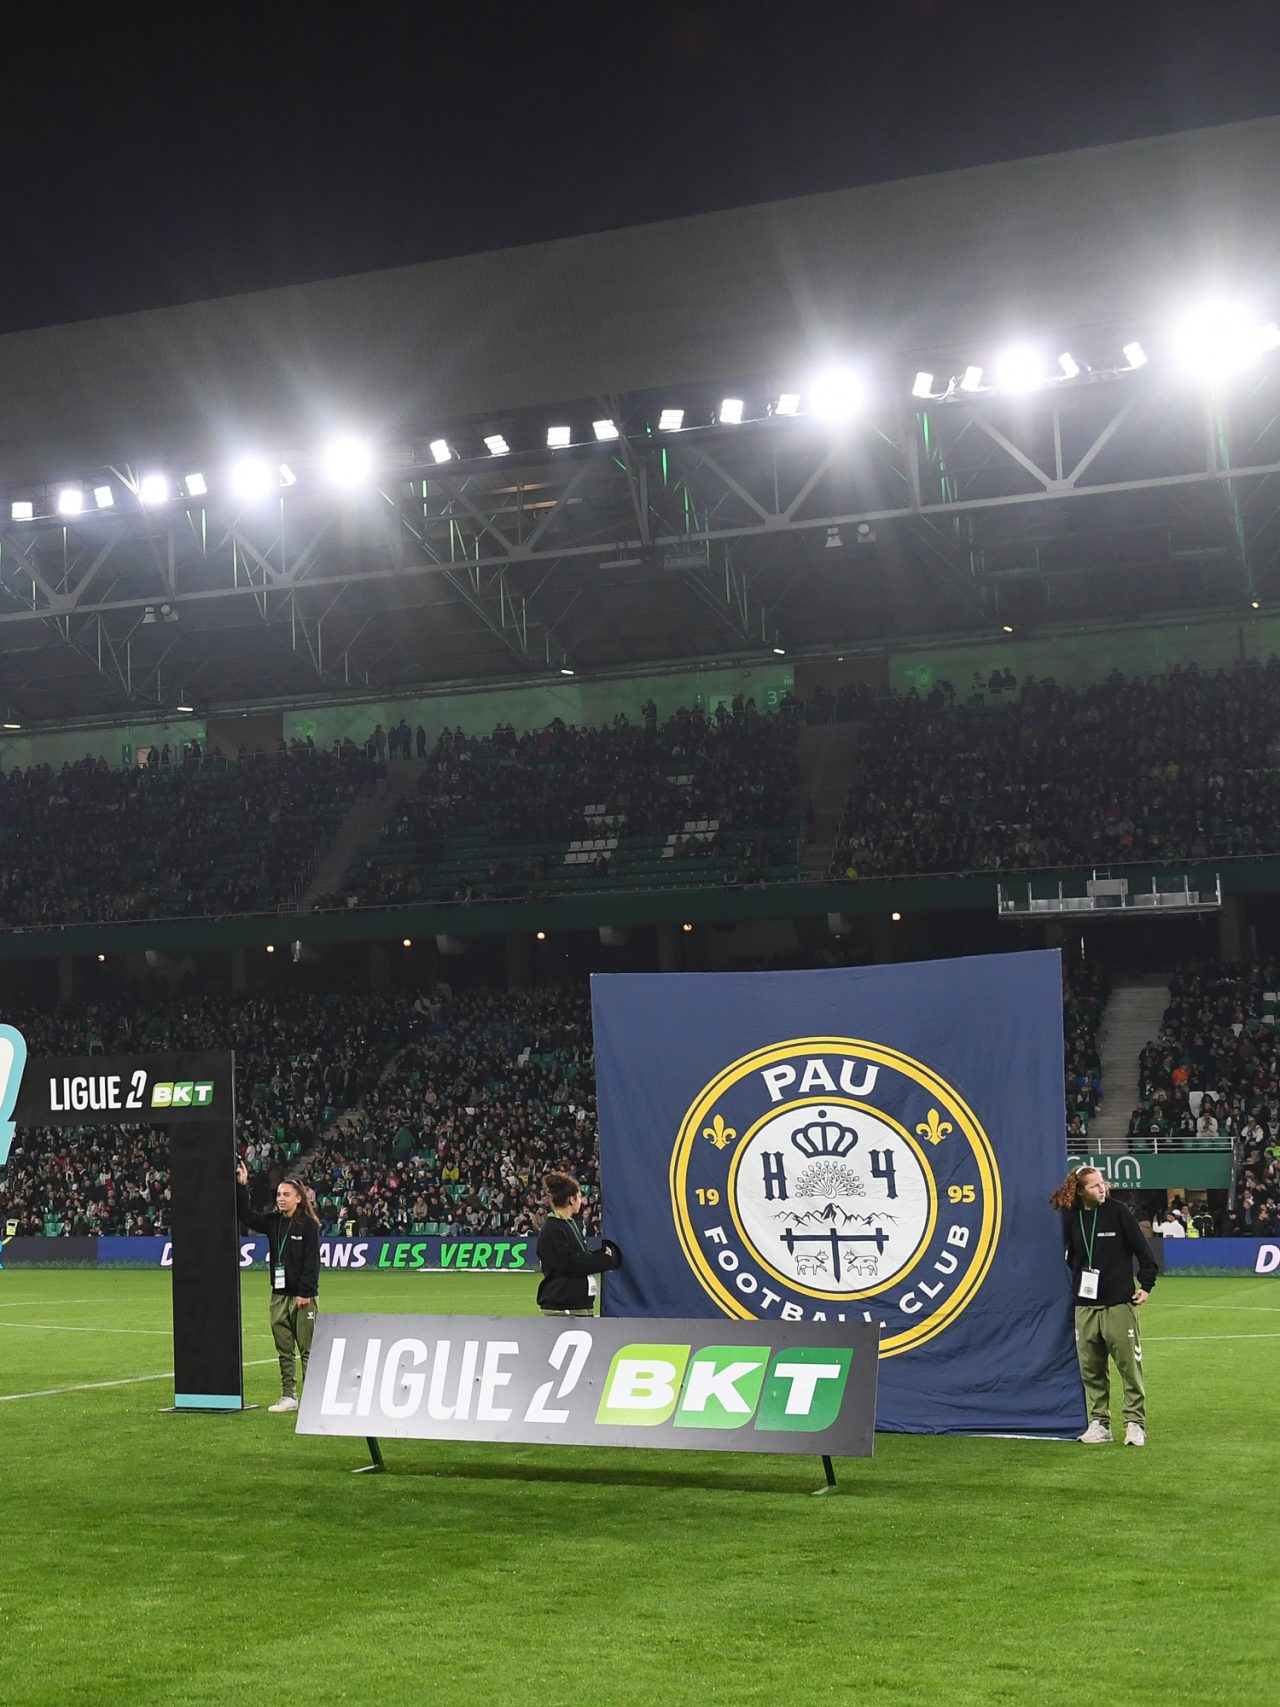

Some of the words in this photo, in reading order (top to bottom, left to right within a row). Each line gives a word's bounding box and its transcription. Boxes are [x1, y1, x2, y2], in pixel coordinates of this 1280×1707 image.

[50, 1076, 120, 1111] LIGUE
[125, 1070, 147, 1109] 2
[152, 1085, 212, 1103] BKT
[761, 1059, 880, 1102] PAU
[695, 1188, 720, 1206] 19
[947, 1184, 976, 1204] 95
[760, 1151, 790, 1201] H
[320, 1243, 368, 1268] ANS
[378, 1243, 425, 1268] LES
[440, 1243, 527, 1268] VERTS
[898, 1224, 970, 1314] CLUB
[320, 1337, 519, 1422] LIGUE
[524, 1330, 593, 1424] 2
[605, 1359, 841, 1416] BKT
